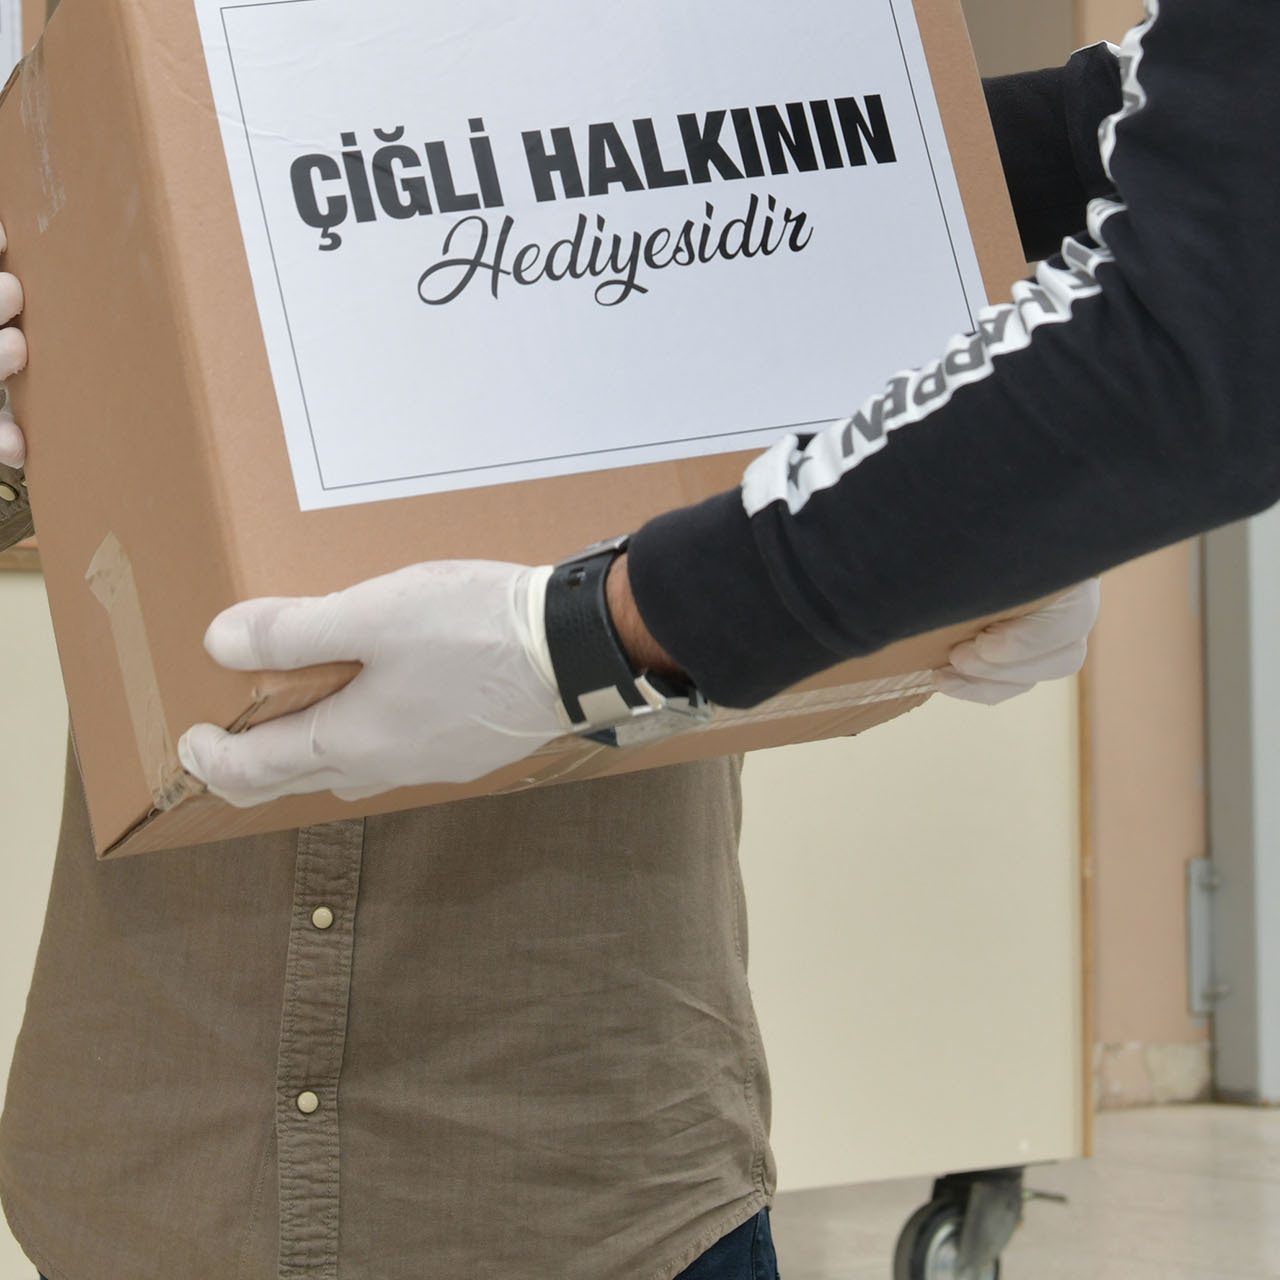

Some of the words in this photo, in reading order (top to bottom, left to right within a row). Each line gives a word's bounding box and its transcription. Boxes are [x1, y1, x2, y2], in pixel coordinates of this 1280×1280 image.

[290, 117, 505, 252] ÇİĞLİ
[521, 93, 898, 204] HALKININ
[417, 192, 814, 307] Hediyesidir
